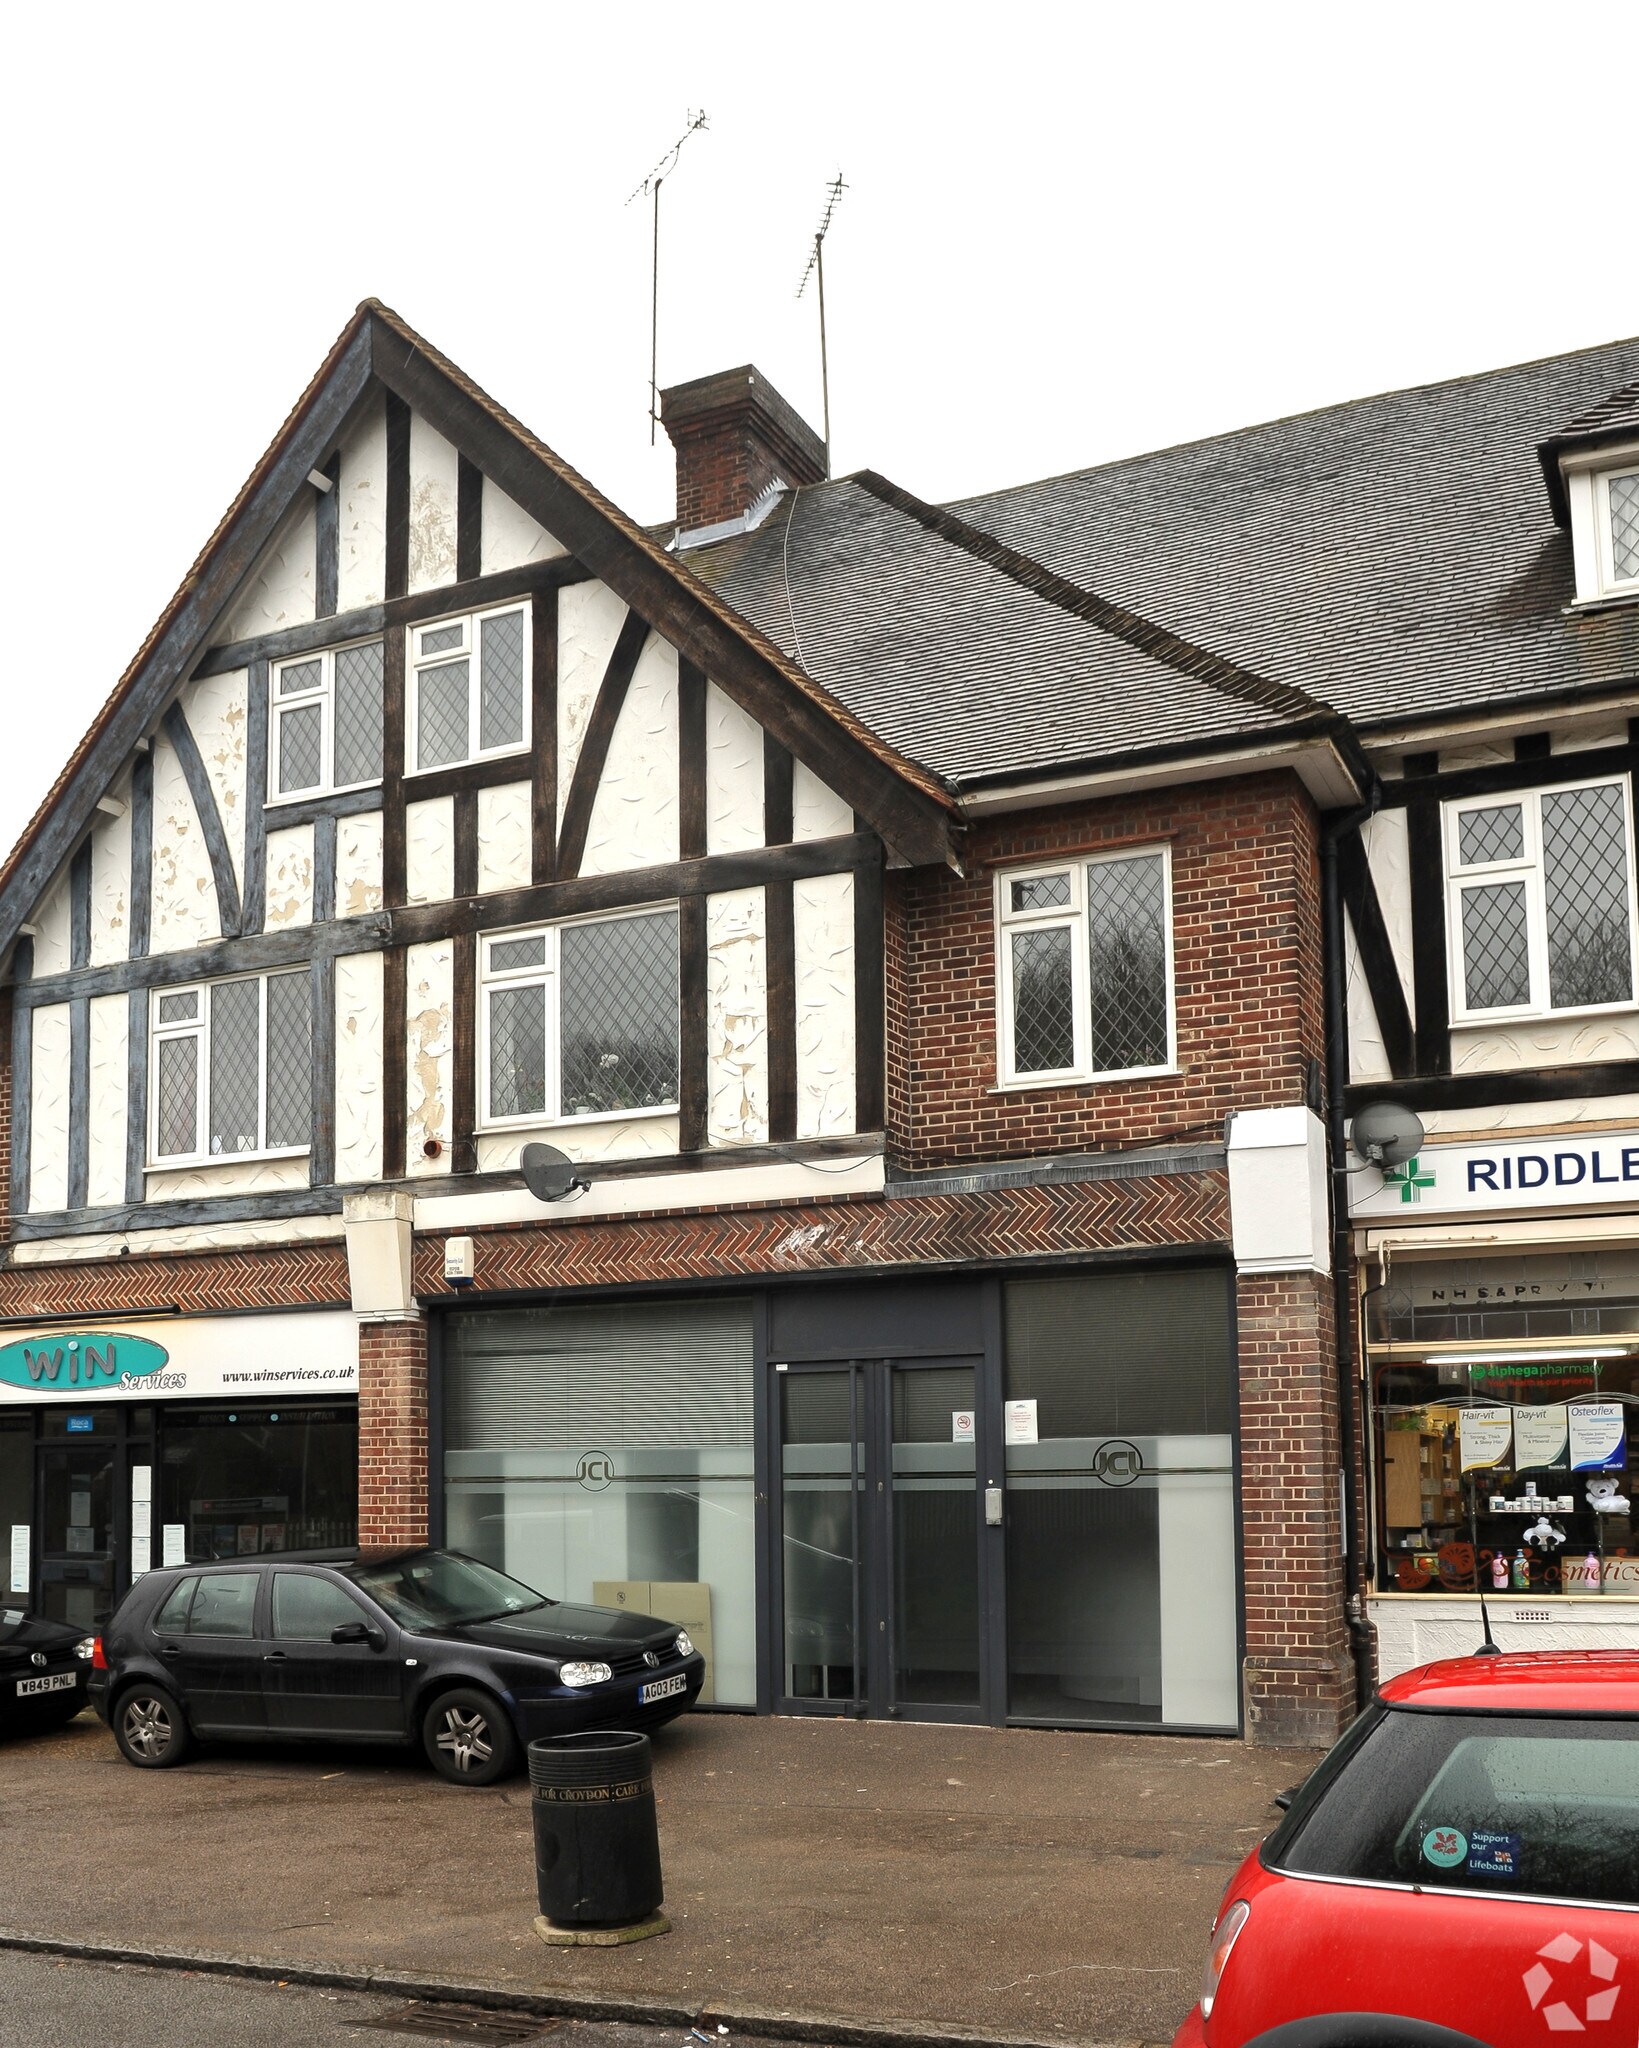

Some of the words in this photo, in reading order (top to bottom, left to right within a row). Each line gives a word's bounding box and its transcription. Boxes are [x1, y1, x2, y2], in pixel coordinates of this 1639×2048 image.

[1432, 1287, 1489, 1300] NHS
[1497, 1287, 1506, 1297] &
[118, 1370, 187, 1390] Services
[223, 1366, 354, 1382] www.winservices.co.uk
[1561, 1377, 1594, 1386] priority
[1462, 1410, 1495, 1420] Hair-vit
[1517, 1409, 1547, 1421] Day-vit
[1571, 1406, 1615, 1417] Osteoflex
[71, 1418, 89, 1426] Roca
[1522, 1558, 1639, 1582] Cosmetics
[22, 1678, 50, 1693] W849
[52, 1675, 72, 1688] PNL
[645, 1681, 668, 1700] AG03
[541, 1788, 556, 1800] FOR
[560, 1790, 610, 1801] CROYDON
[616, 1786, 640, 1797] CARE
[1472, 1832, 1510, 1844] Support
[1471, 1843, 1488, 1851] our
[1469, 1860, 1513, 1873] Lifeboats
